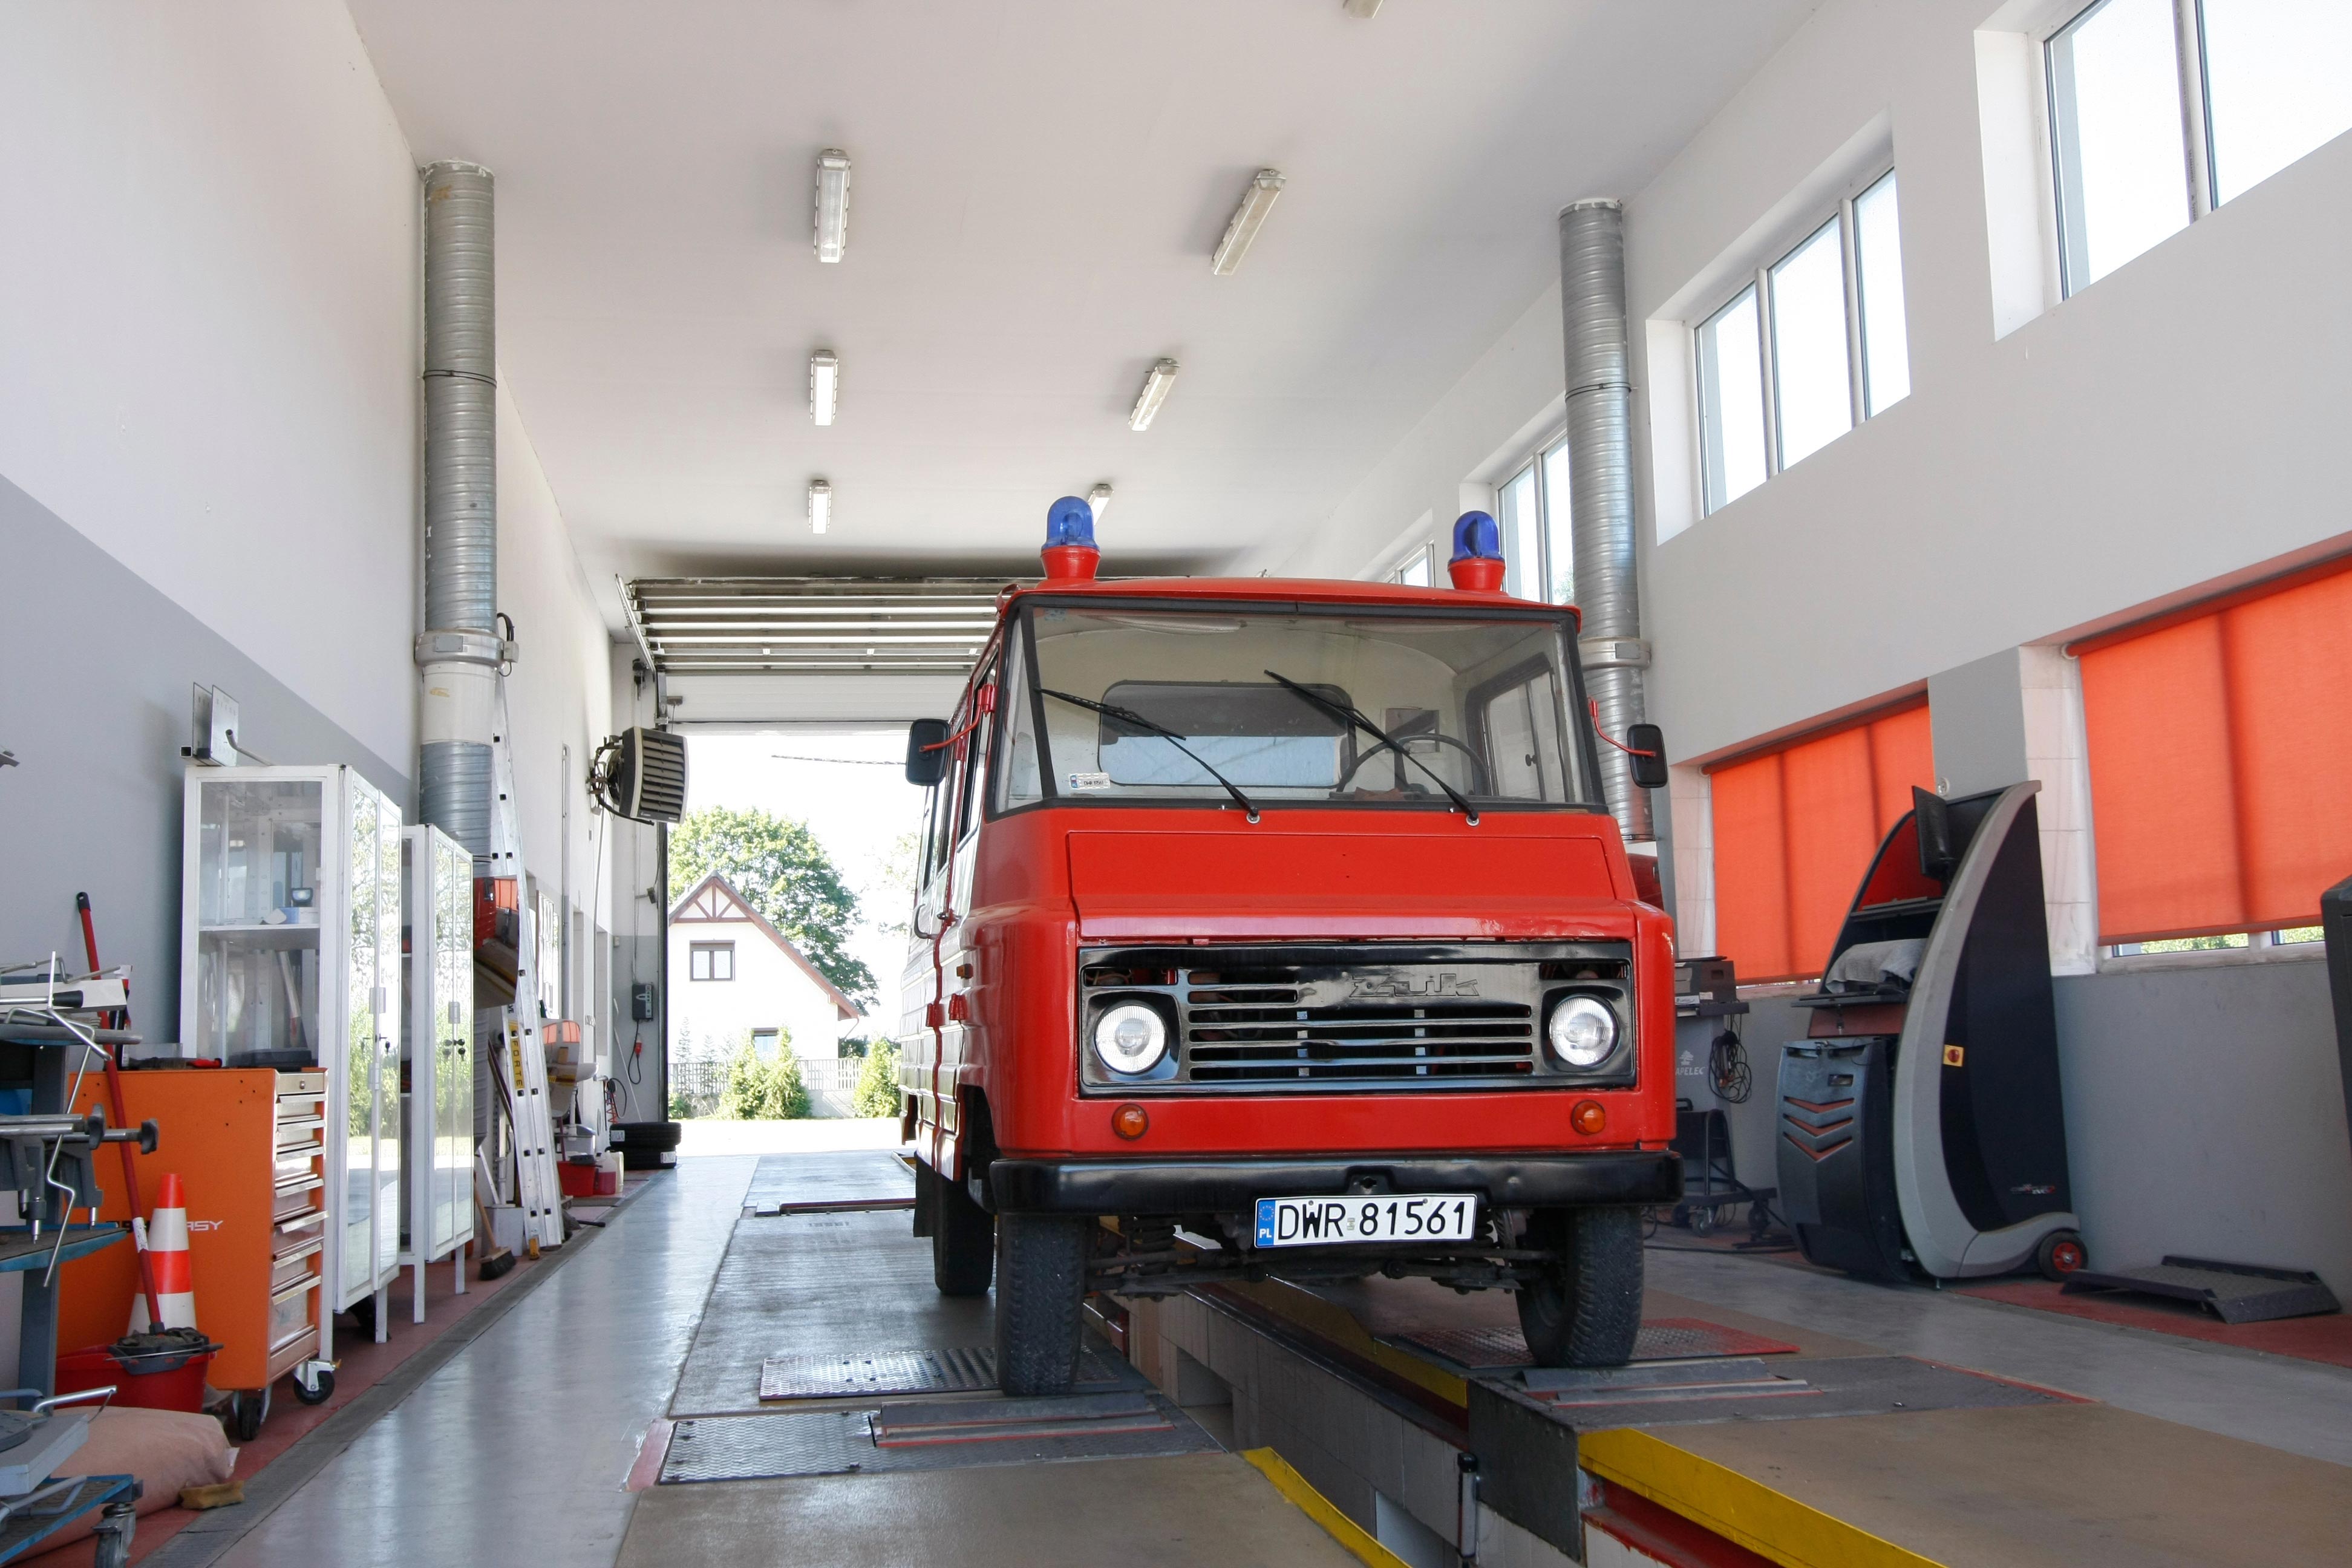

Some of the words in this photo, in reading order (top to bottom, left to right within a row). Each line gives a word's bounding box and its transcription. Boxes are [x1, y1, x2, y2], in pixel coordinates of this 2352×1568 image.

[513, 1040, 523, 1086] FORTE
[1675, 1067, 1705, 1075] APELEC
[187, 1220, 224, 1231] ASY
[1278, 1203, 1347, 1240] DWR
[1359, 1201, 1466, 1236] 81561
[1259, 1227, 1272, 1239] PL
